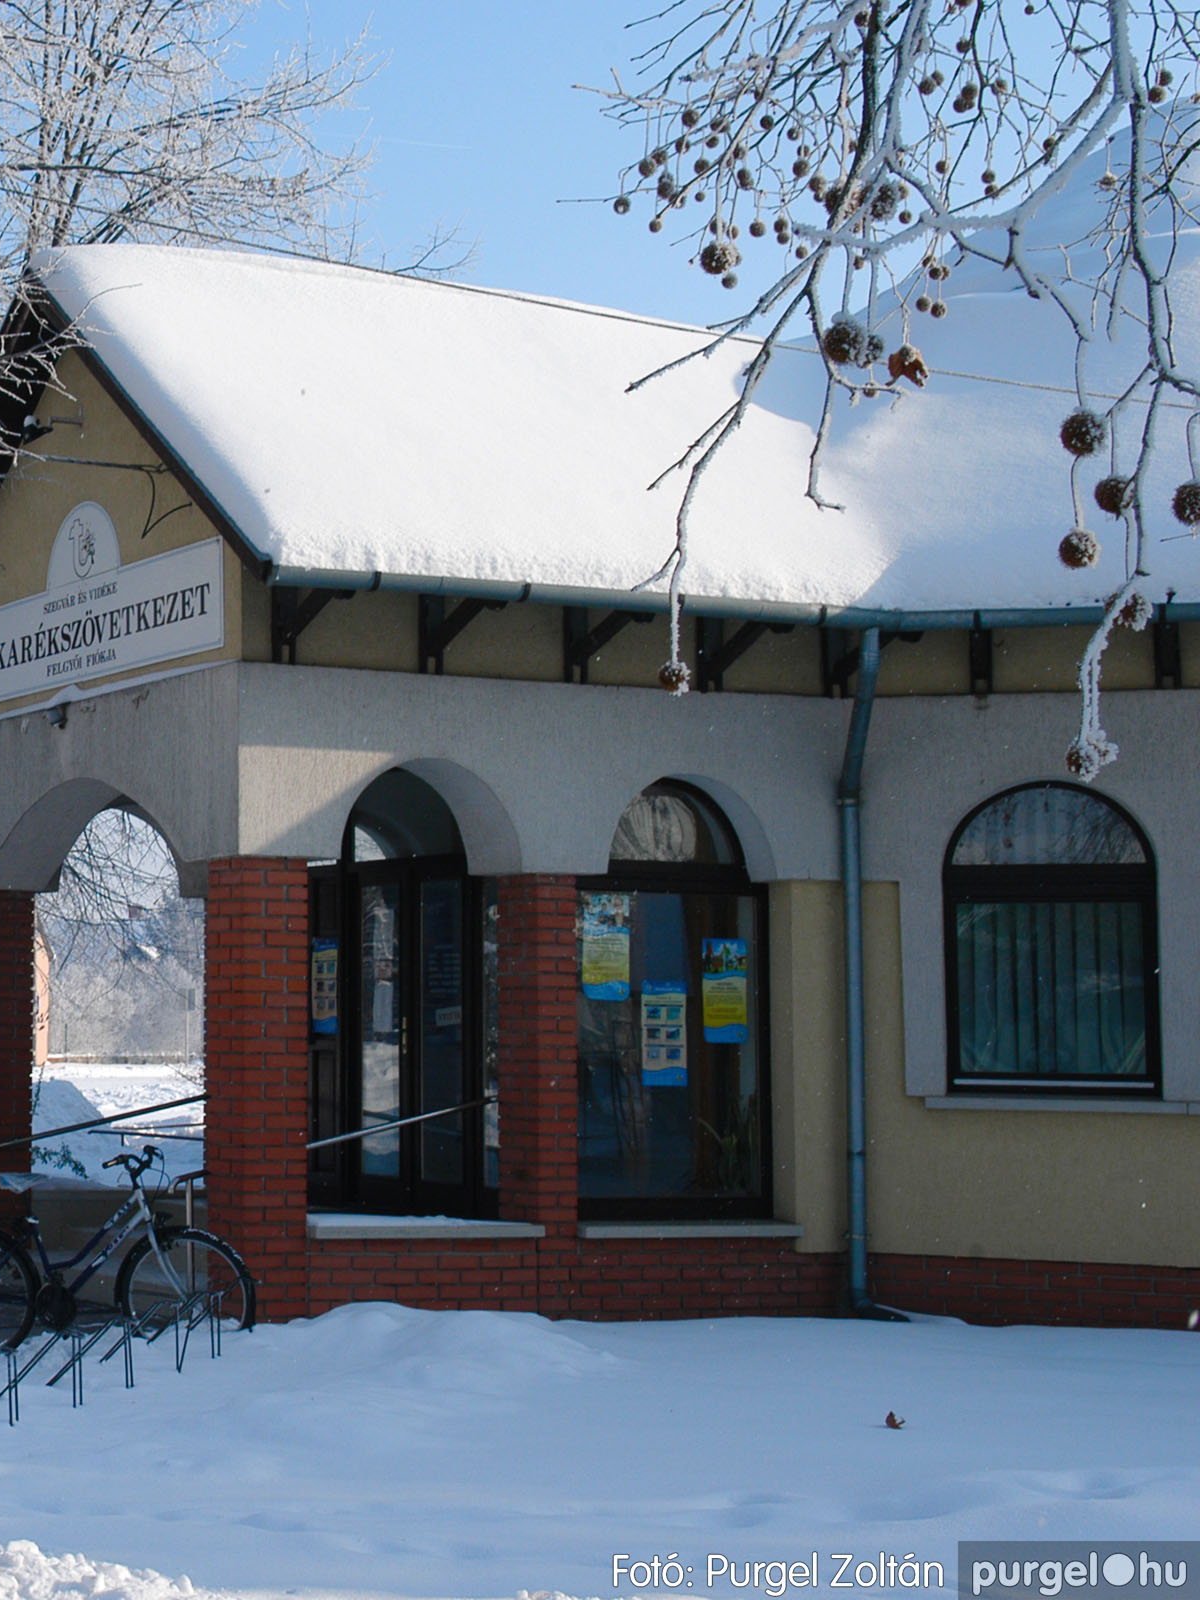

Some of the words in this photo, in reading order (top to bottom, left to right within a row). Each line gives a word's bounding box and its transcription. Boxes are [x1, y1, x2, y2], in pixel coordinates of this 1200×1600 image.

[43, 593, 76, 614] SZEGVÁR
[78, 589, 88, 605] ÉS
[89, 580, 118, 601] VIDÉKE
[86, 648, 117, 669] FIÓKJA
